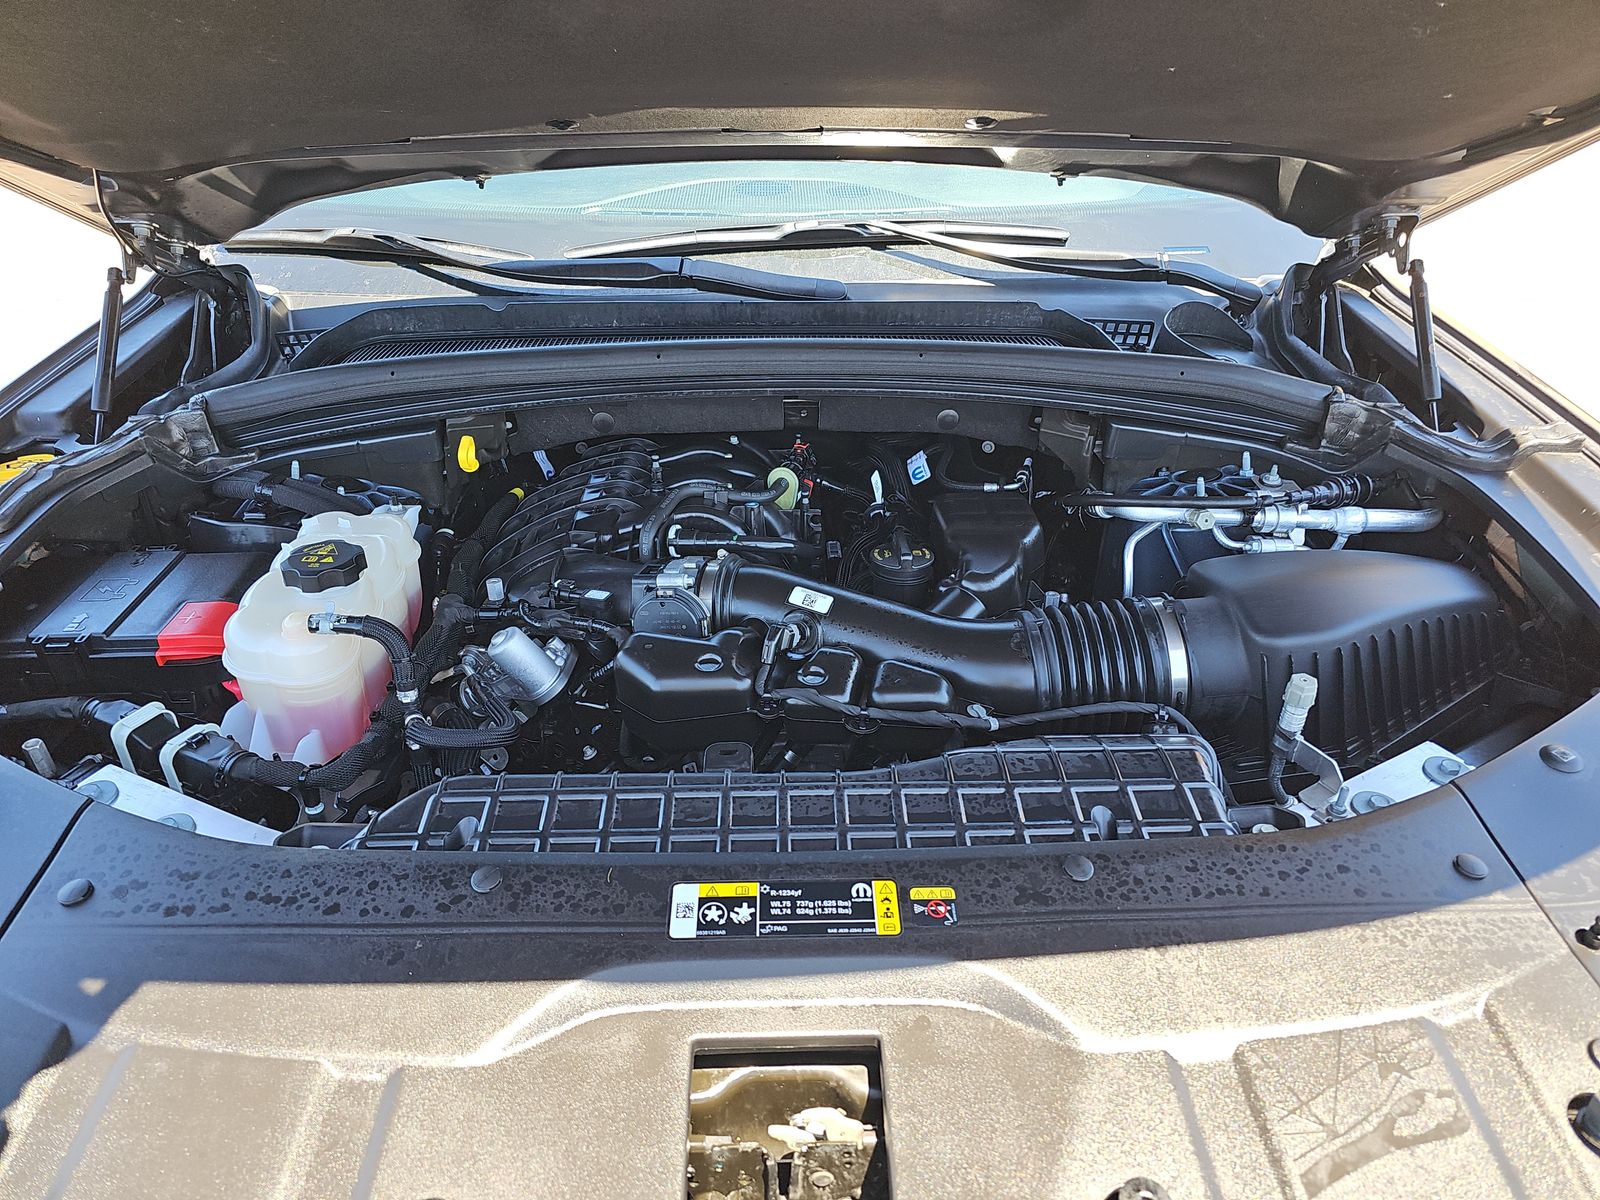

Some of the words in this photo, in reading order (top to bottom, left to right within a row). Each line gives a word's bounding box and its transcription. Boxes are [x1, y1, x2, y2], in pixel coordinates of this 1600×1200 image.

[770, 889, 802, 897] R-1234yf
[770, 900, 791, 908] WL75
[796, 900, 814, 908] 737g
[814, 899, 837, 908] (1.625
[837, 899, 852, 908] lbs)
[796, 907, 814, 916] 624g
[814, 907, 837, 916] (1.375
[837, 907, 853, 915] lbs)
